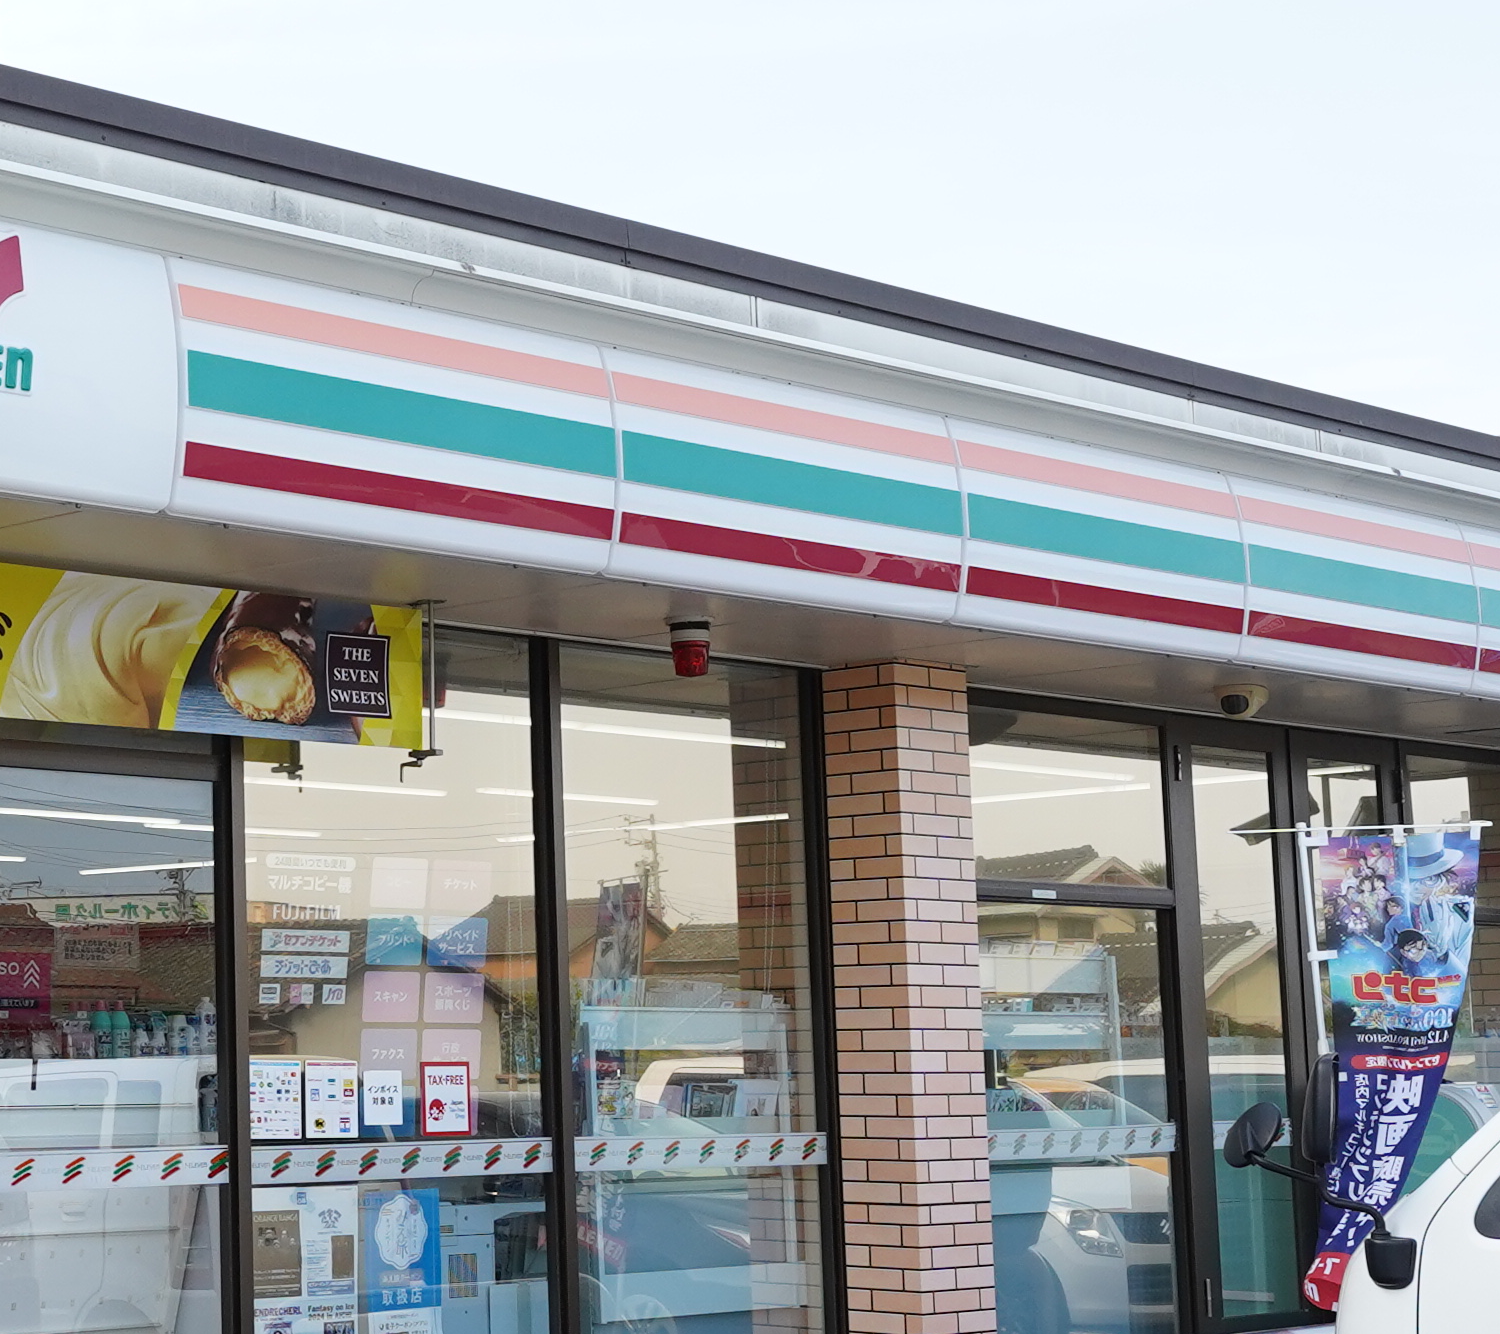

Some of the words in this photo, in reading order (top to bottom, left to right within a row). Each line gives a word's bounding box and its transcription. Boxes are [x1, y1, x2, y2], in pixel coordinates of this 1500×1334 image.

[342, 647, 371, 664] THE
[333, 665, 381, 687] SEVEN
[331, 686, 385, 708] SWEETS
[268, 875, 352, 893] マルチコピー機
[444, 879, 477, 890] チケット
[439, 943, 475, 954] サービス
[373, 991, 408, 1002] スキャン
[435, 986, 472, 997] スポーツ
[372, 1049, 404, 1059] ファクス
[367, 1085, 398, 1094] インボイス
[372, 1097, 394, 1106] 対象店
[382, 1288, 422, 1306] 取扱店
